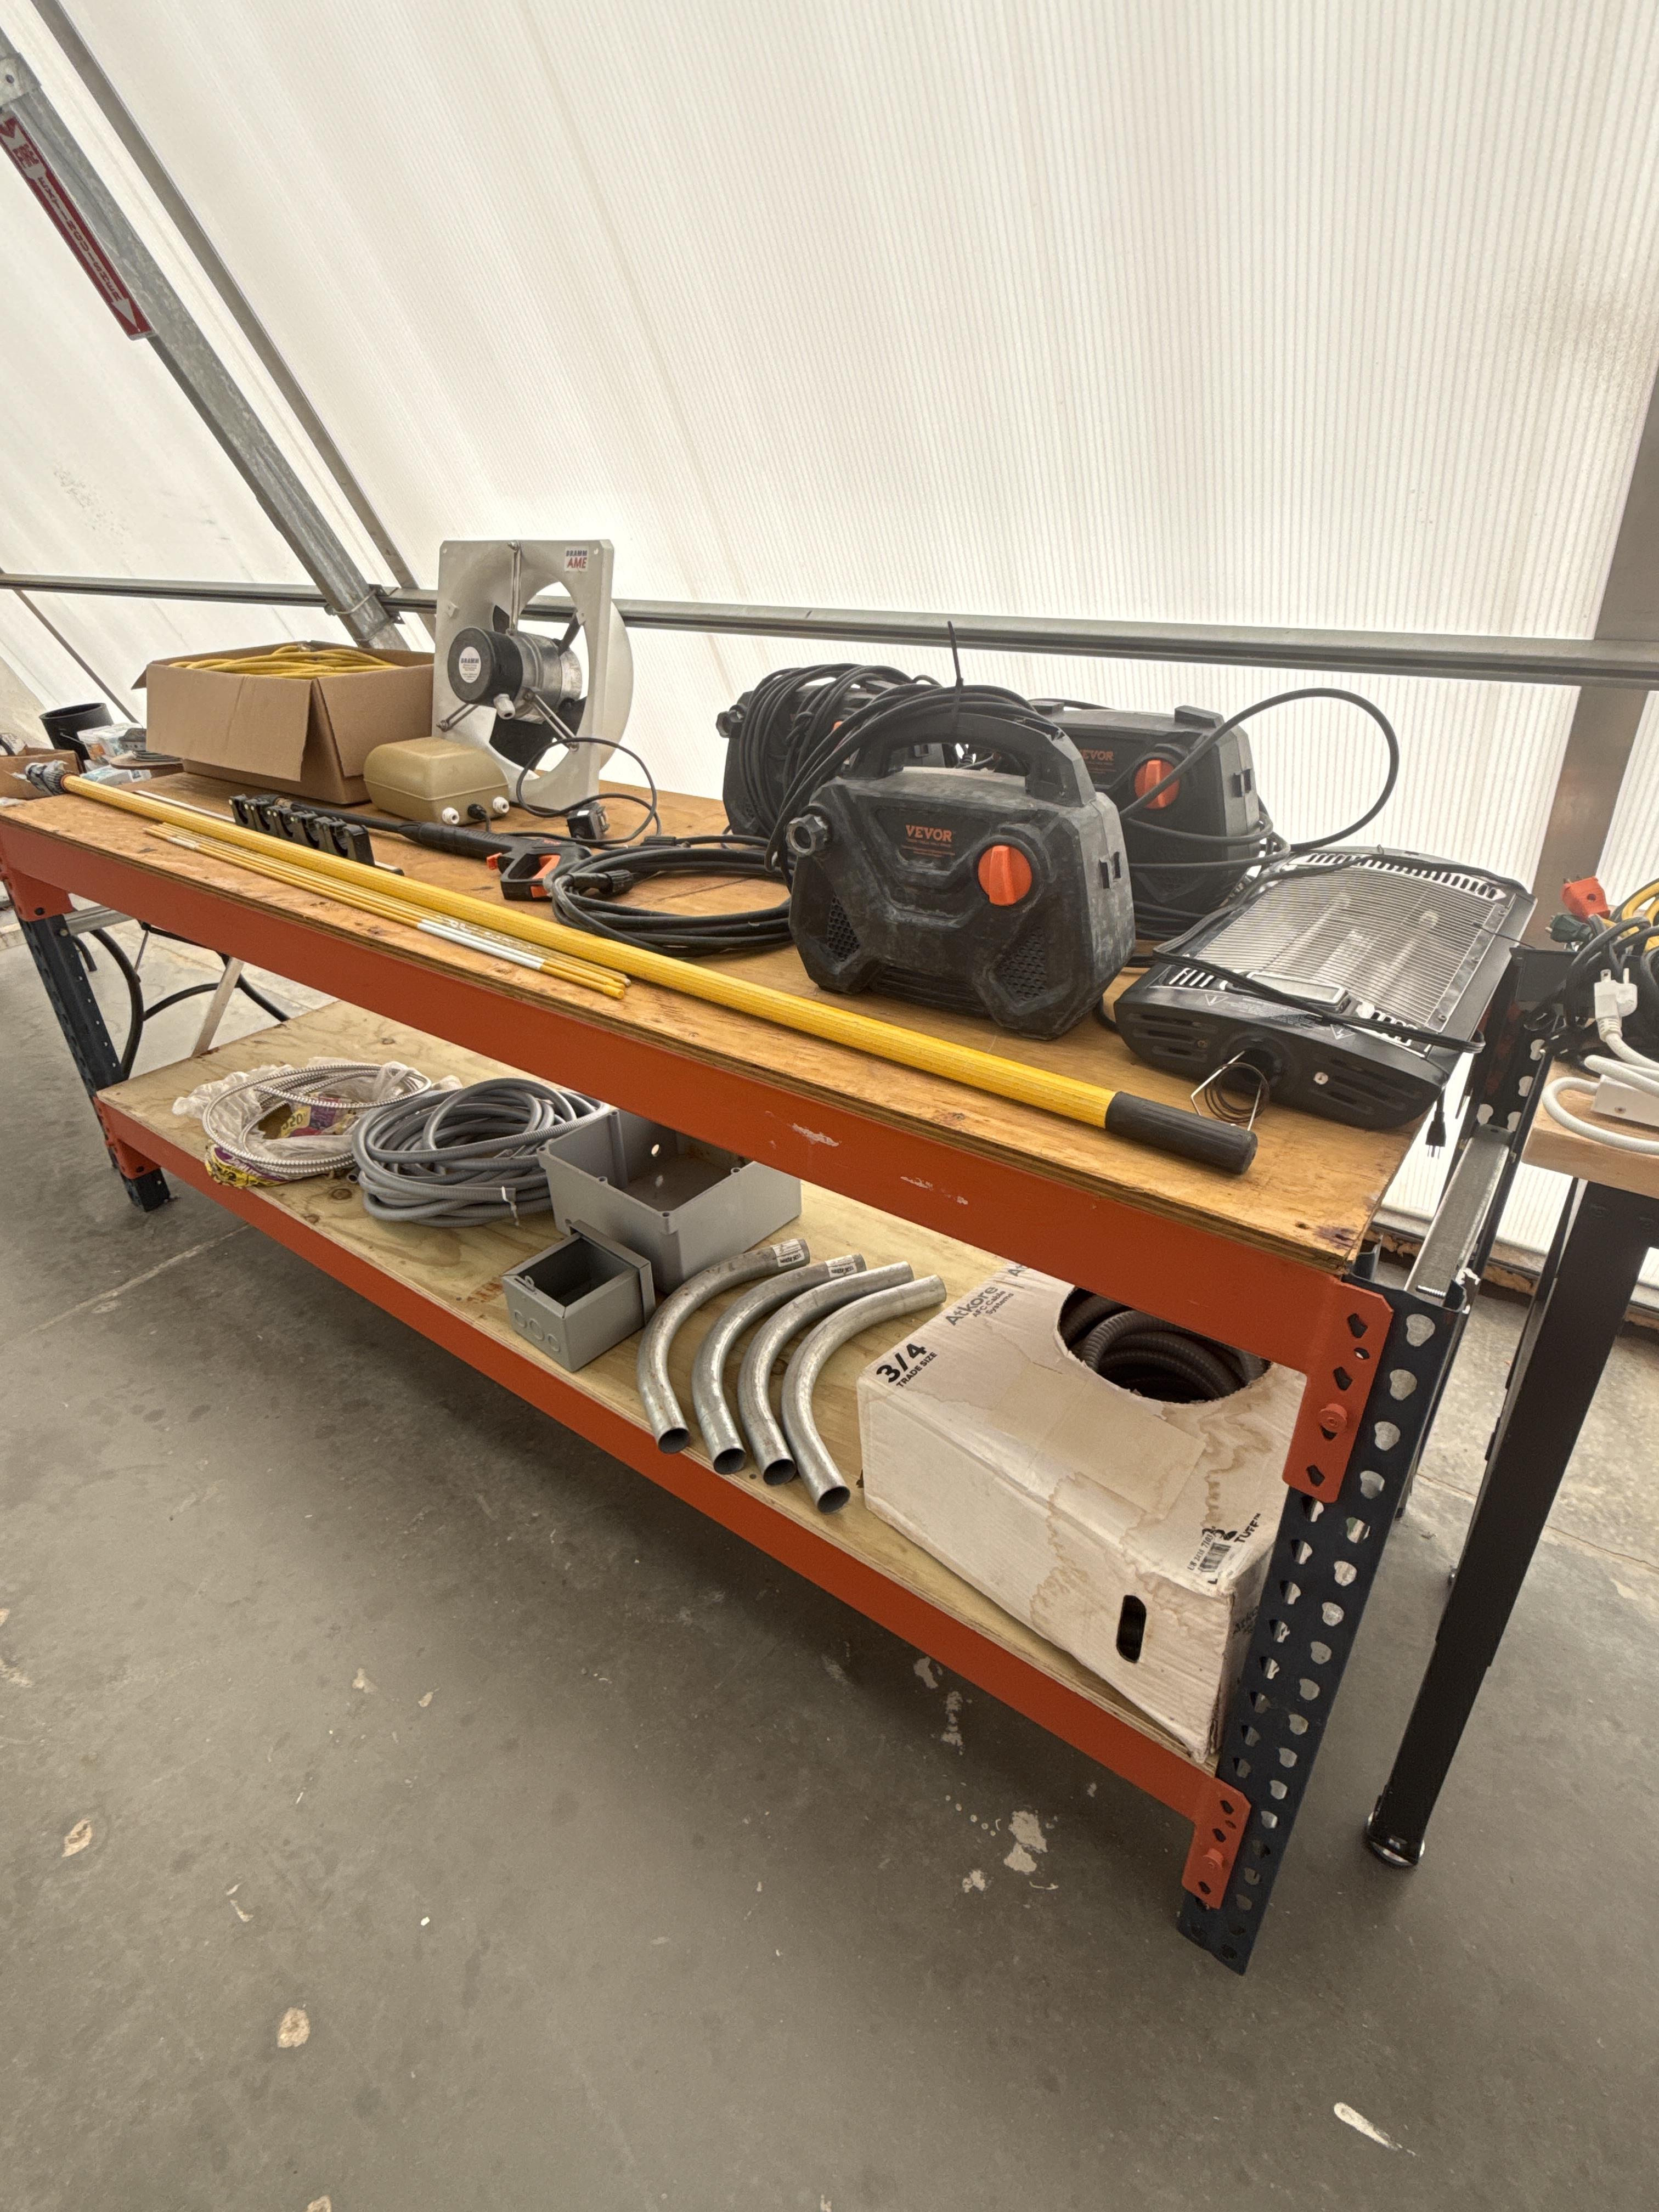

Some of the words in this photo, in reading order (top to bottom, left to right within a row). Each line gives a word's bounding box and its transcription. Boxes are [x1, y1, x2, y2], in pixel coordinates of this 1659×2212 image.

[37, 176, 123, 302] EXTINGUISHER
[567, 557, 587, 568] AME
[905, 825, 952, 842] VEVOR
[945, 1286, 998, 1325] Atkore
[972, 1305, 988, 1317] AFC
[985, 1290, 1006, 1306] Cable
[985, 1293, 1014, 1314] Systems
[876, 1343, 927, 1383] 3/4
[896, 1365, 922, 1387] TRADE
[919, 1352, 938, 1367] SIZE
